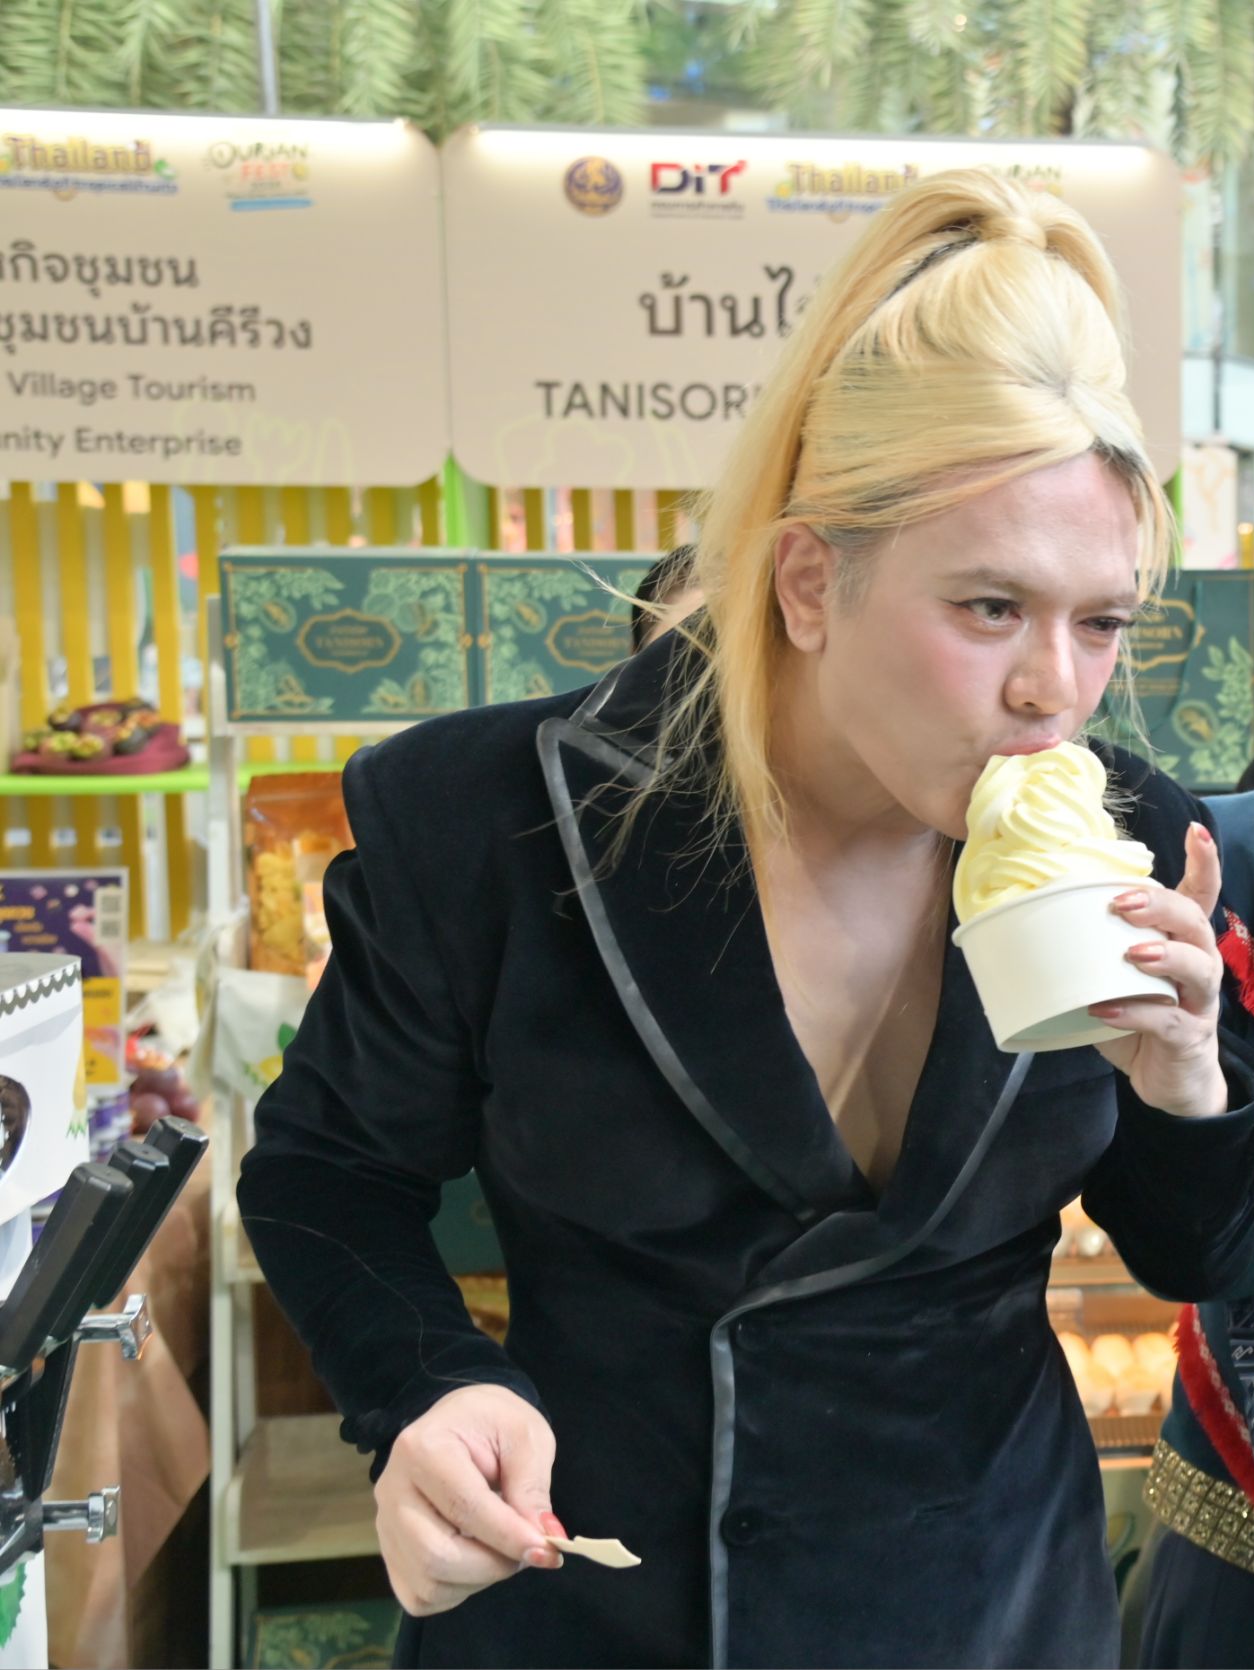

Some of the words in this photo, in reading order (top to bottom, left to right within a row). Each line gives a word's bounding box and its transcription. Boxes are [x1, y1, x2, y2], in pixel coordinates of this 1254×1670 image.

[0, 240, 200, 299] กิจชุมชน
[637, 264, 806, 338] บ้านไ
[6, 371, 118, 406] Village
[126, 373, 256, 402] Tourism
[535, 380, 760, 421] TANISOR
[74, 427, 243, 460] Enterprise
